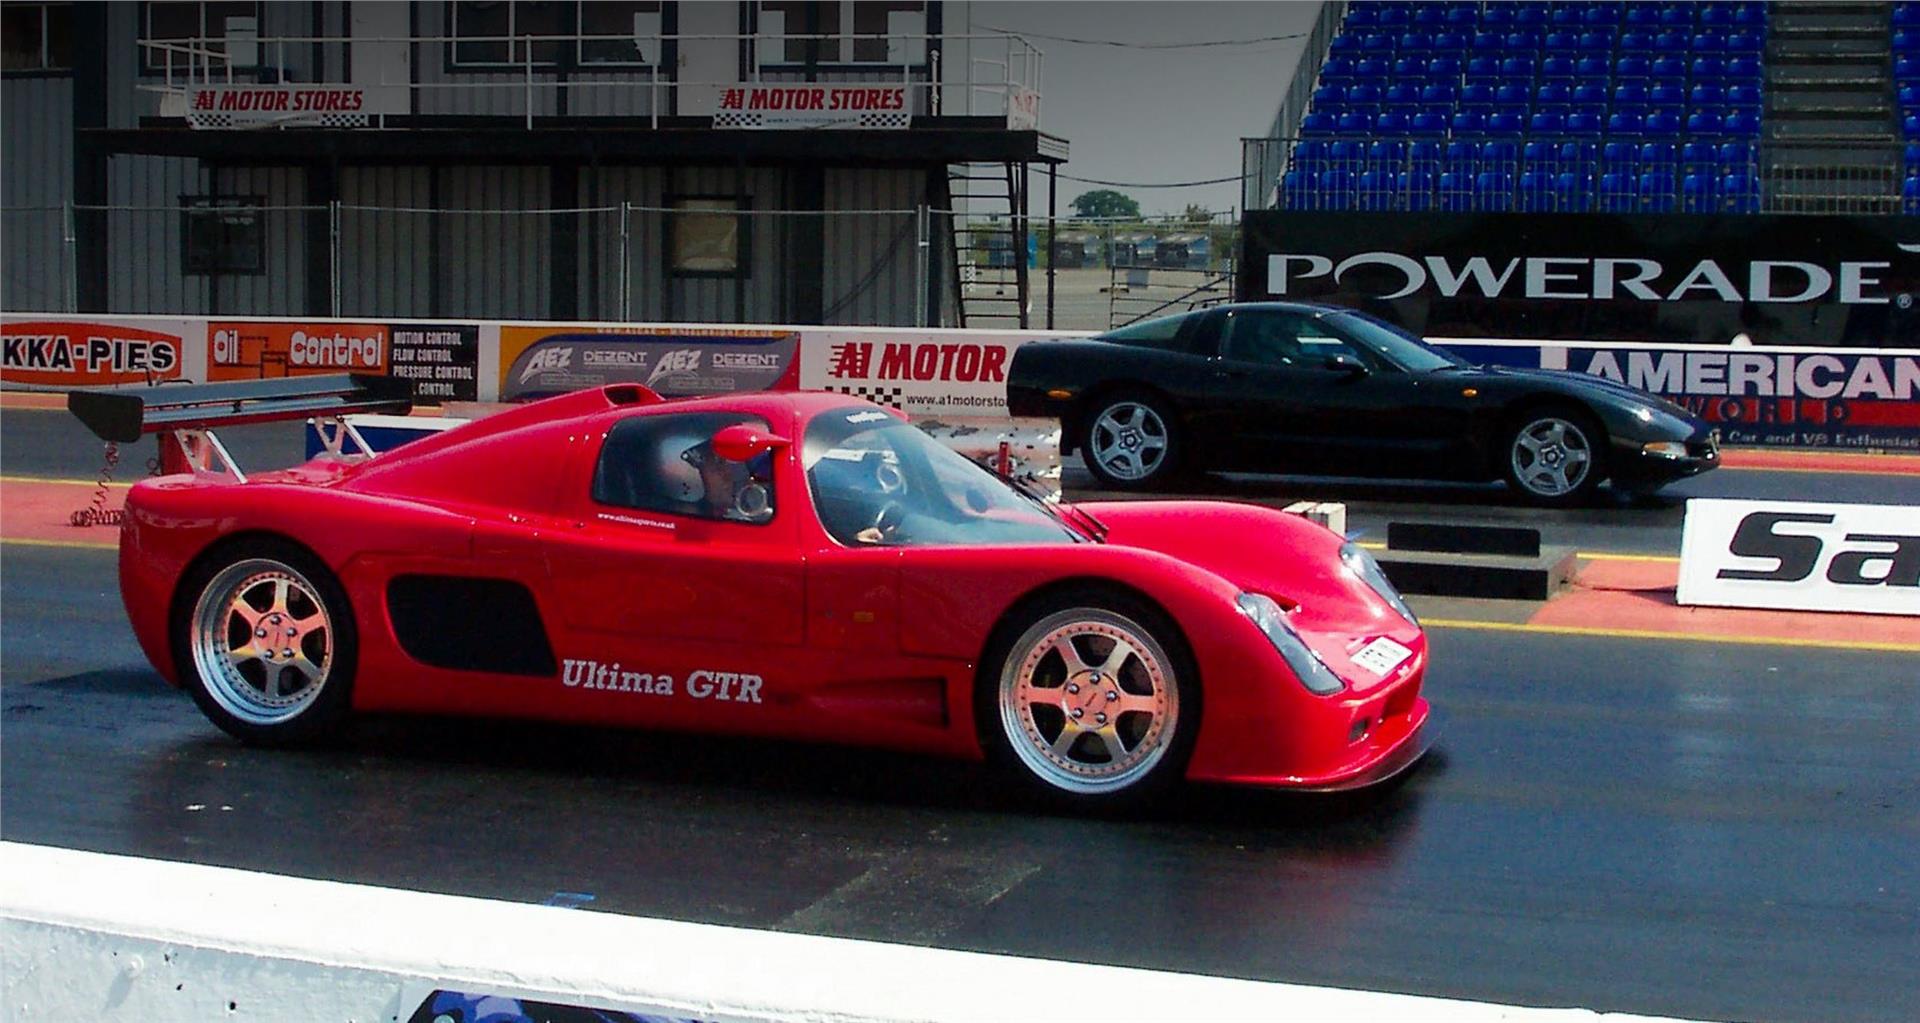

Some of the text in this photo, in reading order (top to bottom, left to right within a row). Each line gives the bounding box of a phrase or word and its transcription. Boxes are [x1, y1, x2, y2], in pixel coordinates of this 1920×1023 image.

[220, 90, 289, 111] MOTOR
[292, 90, 363, 111] STORES
[749, 88, 825, 110] MOTOR
[829, 88, 905, 110] STORES
[1267, 251, 1890, 304] POWERADE
[213, 329, 383, 366] Oil Control
[393, 331, 462, 345] MOTION CONTROL
[393, 348, 453, 362] FLOW CONTROL
[519, 347, 573, 385] AEZ
[583, 350, 648, 363] DEZENT
[877, 343, 1007, 382] MOTOR
[393, 365, 474, 380] PRESSURE CONTROL
[646, 349, 702, 387] AEZ
[712, 353, 780, 366] DEZENT
[418, 382, 455, 396] CONTROL
[1728, 431, 1757, 443] Car
[1765, 432, 1797, 444] and
[562, 659, 764, 704] Ultima GTR
